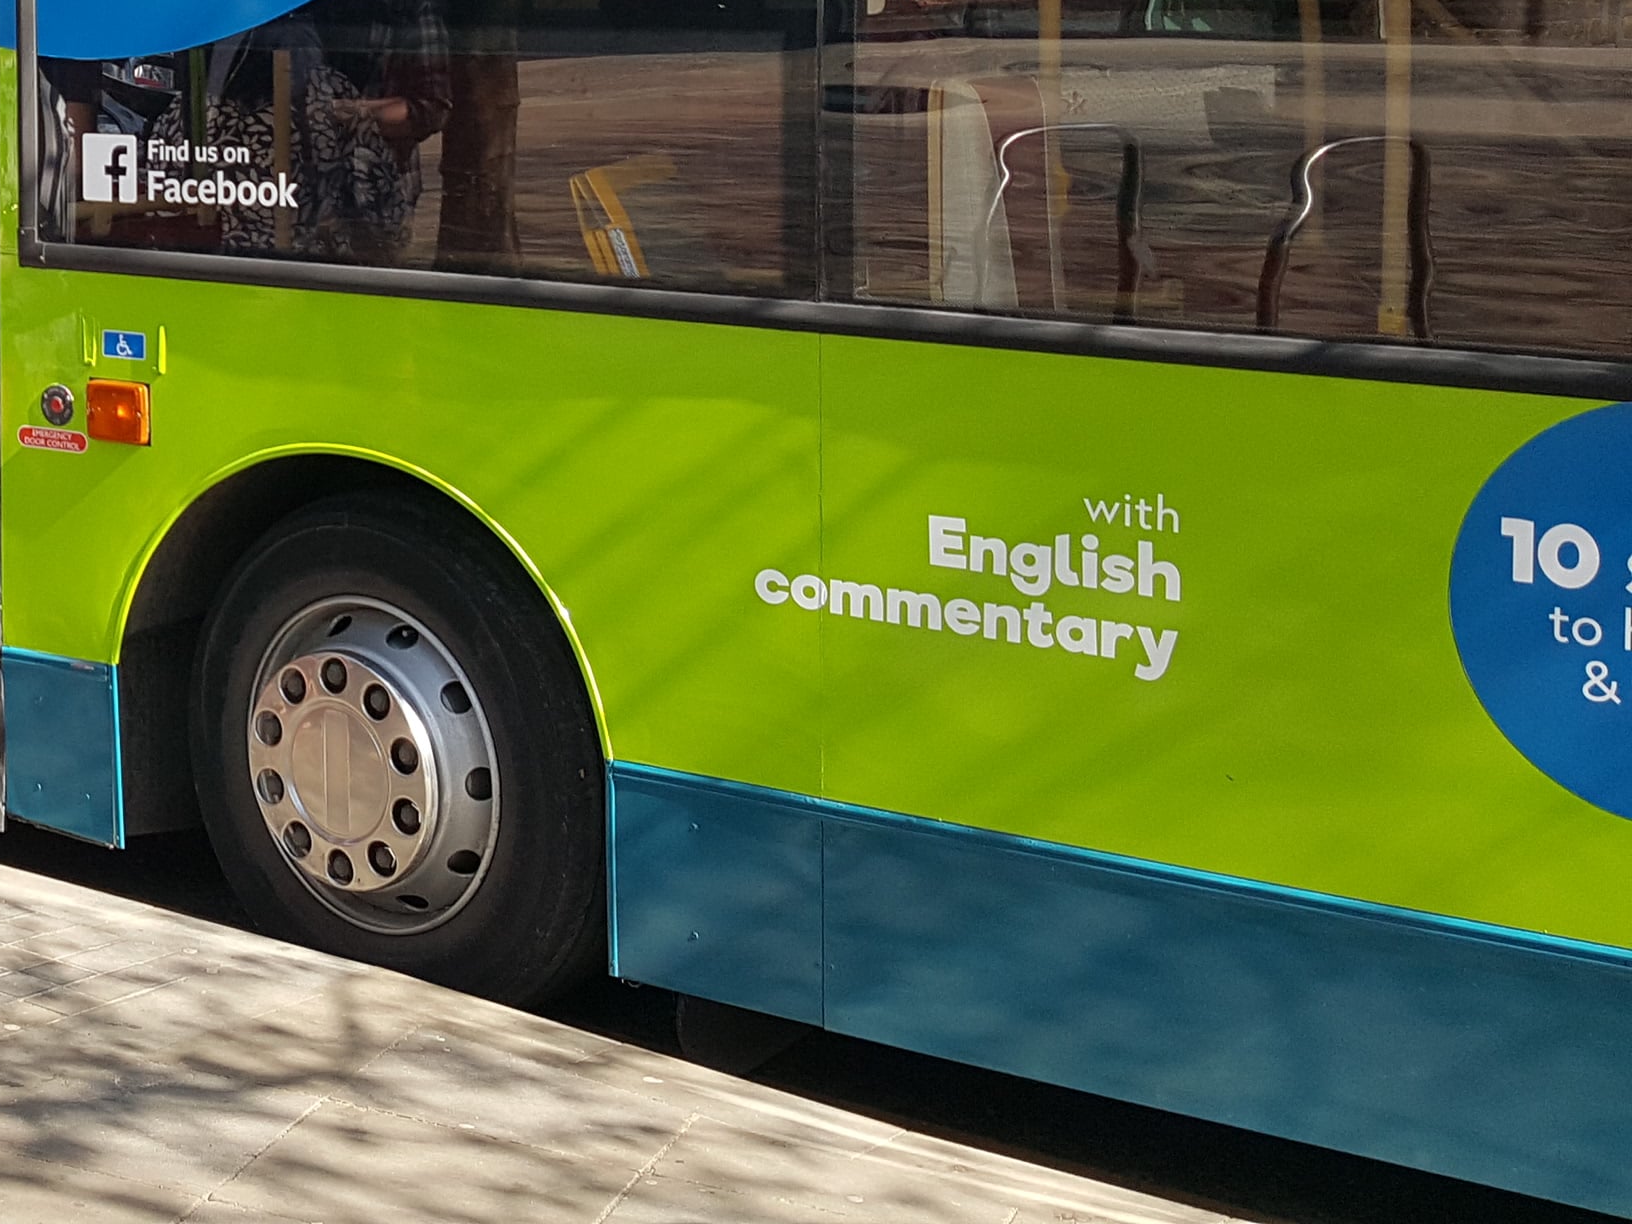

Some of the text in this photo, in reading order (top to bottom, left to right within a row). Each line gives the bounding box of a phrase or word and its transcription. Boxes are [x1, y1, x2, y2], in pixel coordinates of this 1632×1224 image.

[147, 139, 250, 164] Find us on
[147, 170, 298, 208] Facebook
[24, 436, 80, 451] DOOR CONTROL
[32, 428, 73, 440] EMERGENCY
[1083, 494, 1179, 533] with
[928, 514, 1181, 602] English
[1500, 516, 1600, 589] 10
[754, 568, 1178, 681] commentary
[1548, 607, 1603, 646] to
[1582, 660, 1621, 704] &
